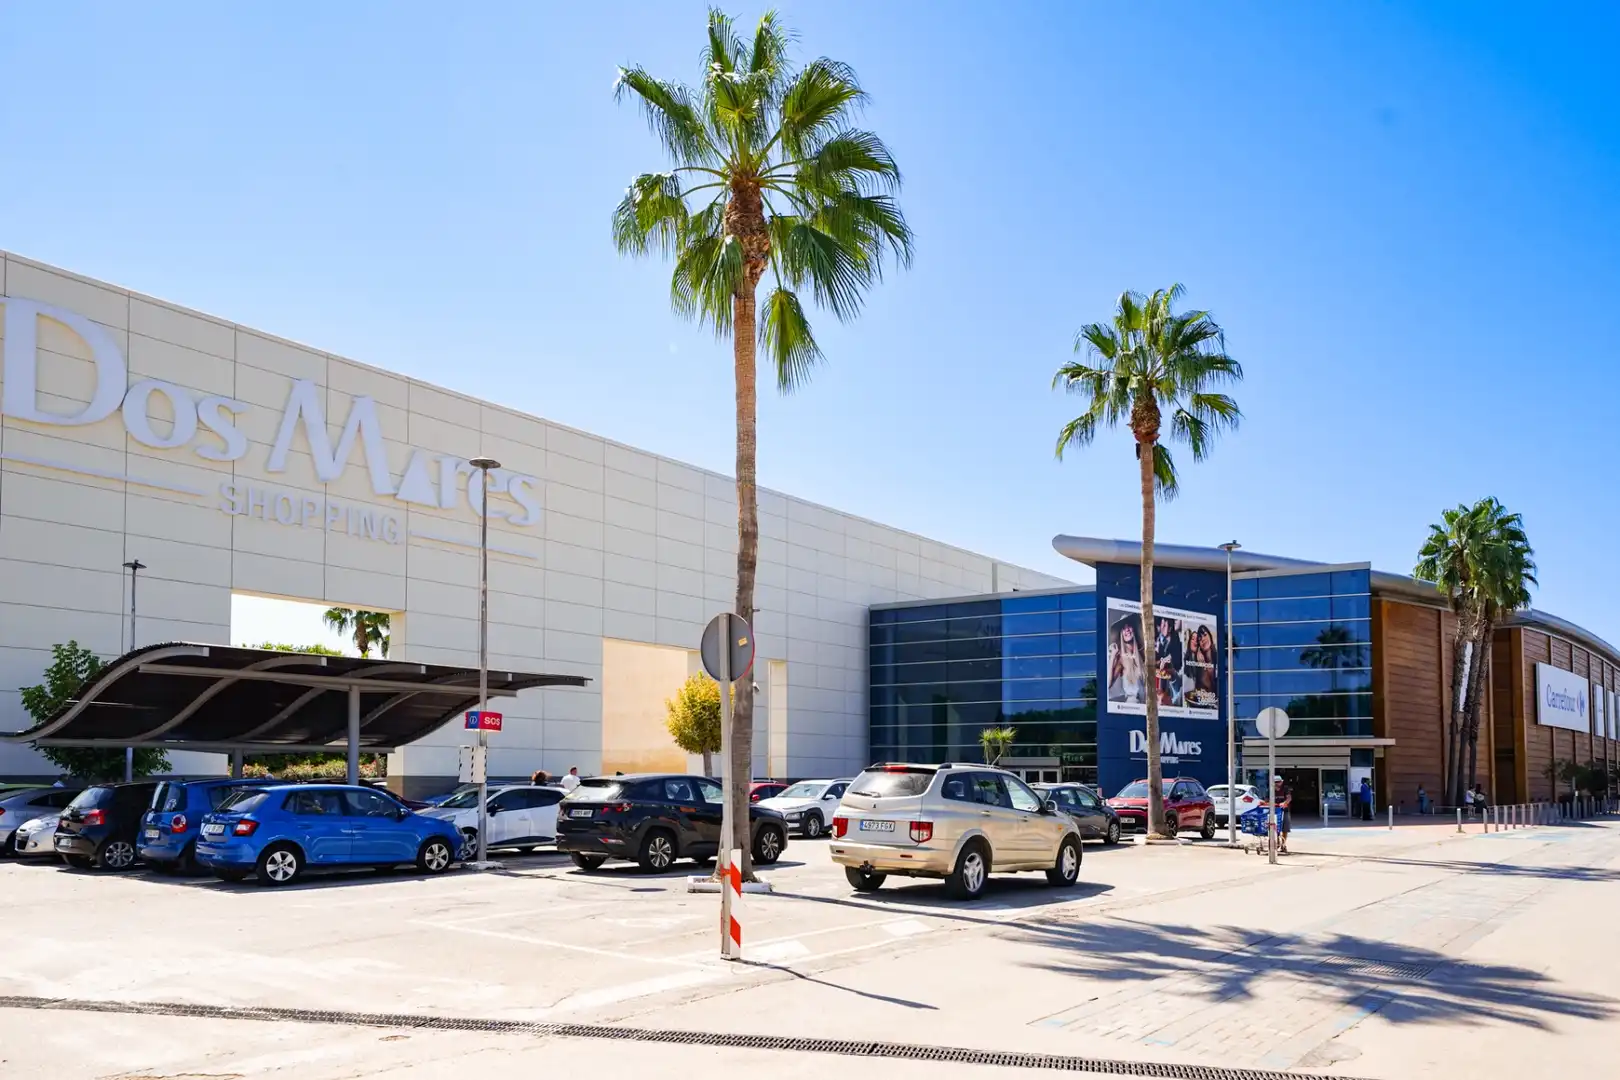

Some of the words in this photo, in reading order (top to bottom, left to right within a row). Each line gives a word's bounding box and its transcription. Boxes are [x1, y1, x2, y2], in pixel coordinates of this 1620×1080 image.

[2, 296, 249, 461] Dos
[267, 378, 541, 526] Mares
[219, 482, 404, 545] SHOPPING
[484, 716, 501, 726] SOS
